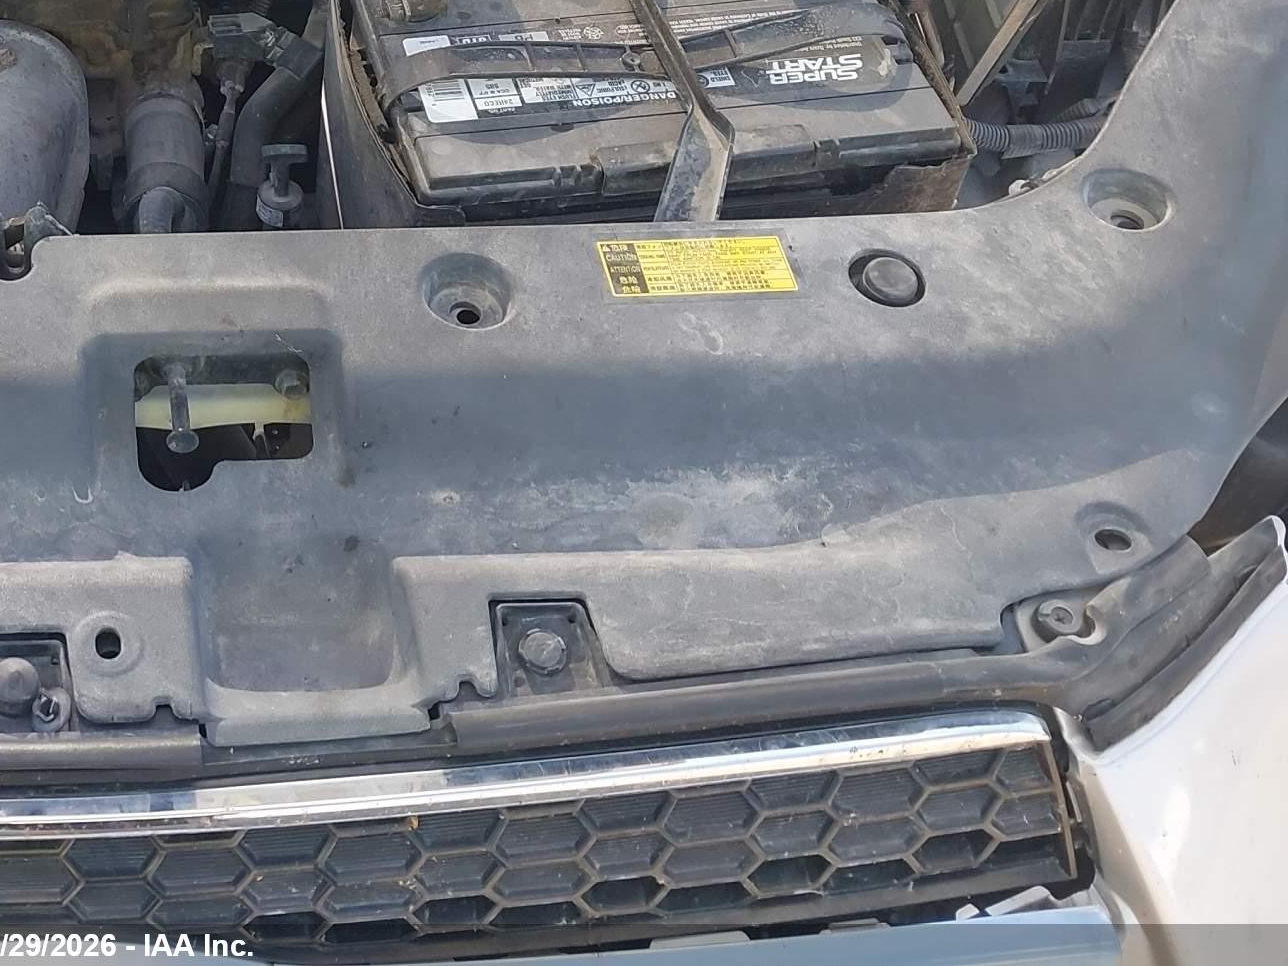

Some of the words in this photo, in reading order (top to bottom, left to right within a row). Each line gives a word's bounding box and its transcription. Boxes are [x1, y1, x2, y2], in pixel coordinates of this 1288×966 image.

[765, 53, 863, 75] START
[769, 68, 858, 85] SUPER
[572, 91, 677, 107] DANGER/POISON
